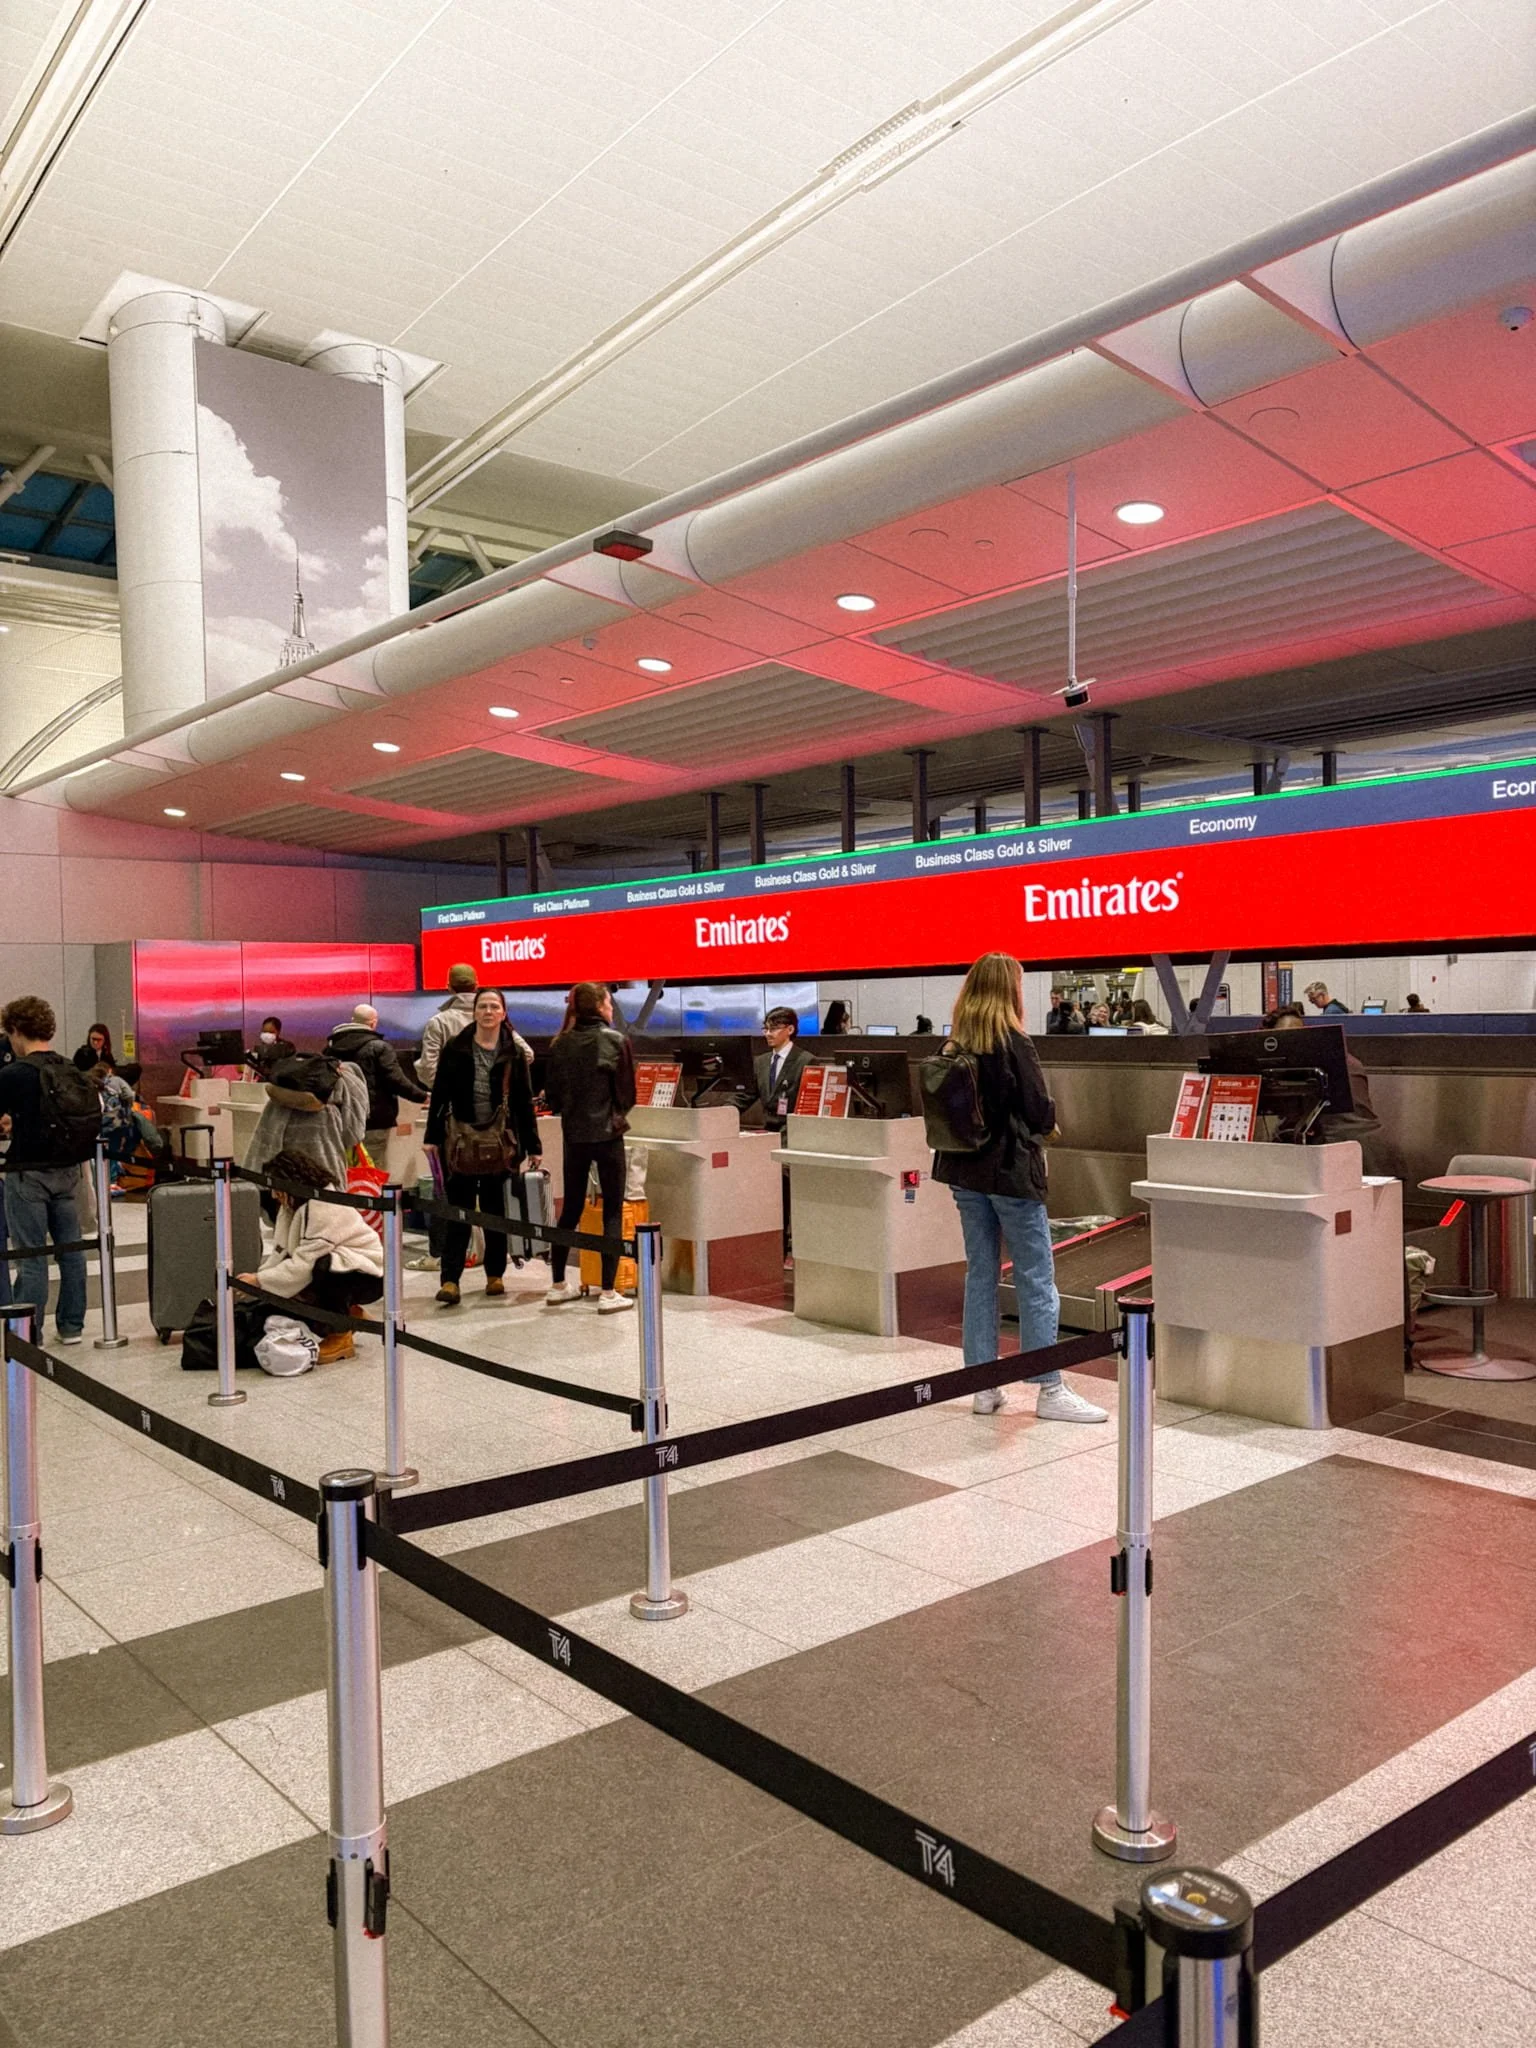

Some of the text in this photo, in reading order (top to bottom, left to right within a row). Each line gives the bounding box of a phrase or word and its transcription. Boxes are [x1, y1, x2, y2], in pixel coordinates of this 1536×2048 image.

[1190, 815, 1258, 834] Economy
[915, 838, 1073, 869] Business Class Gold & Silver
[754, 863, 877, 888] Business Class Gold & Silver
[627, 881, 725, 903] Business Class Gold & Silver
[1023, 873, 1183, 922] Emirates
[533, 899, 590, 913] First Class Platinum
[694, 912, 791, 948] Emirates
[480, 934, 547, 963] Emirates
[913, 1383, 932, 1404] T4
[655, 1444, 679, 1468] T4
[548, 1627, 571, 1667] T4
[914, 1828, 955, 1888] T4
